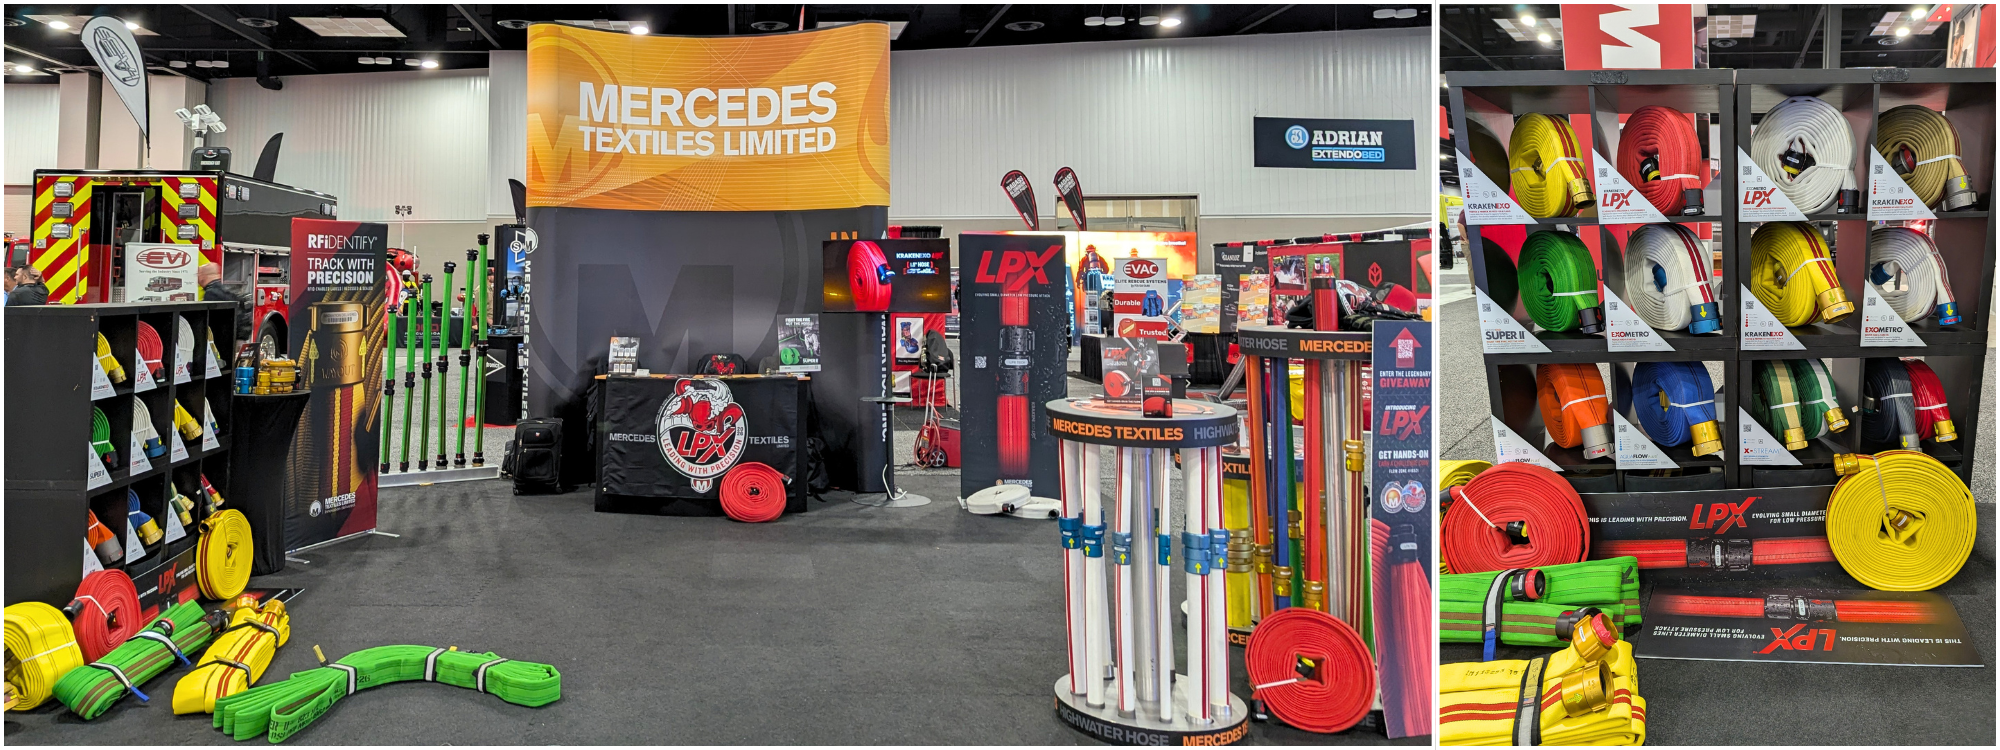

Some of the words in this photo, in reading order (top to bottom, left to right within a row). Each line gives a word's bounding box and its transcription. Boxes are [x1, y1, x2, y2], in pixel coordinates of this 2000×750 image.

[578, 81, 837, 127] MERCEDES
[578, 125, 716, 156] TEXTILES
[722, 126, 837, 156] LIMITED
[1312, 130, 1382, 146] ADRIAN
[1312, 150, 1382, 158] EXTENDOBED
[1602, 190, 1634, 209] LPX
[1743, 188, 1776, 207] LPX
[141, 251, 188, 265] EVI
[307, 258, 344, 270] TRACK
[347, 258, 374, 270] WITH
[975, 245, 1062, 291] LPX
[1124, 264, 1157, 274] EVAC
[308, 271, 373, 284] PRECISION
[1486, 331, 1517, 340] SUPER
[1256, 338, 1288, 350] HOSE
[1300, 340, 1372, 353] MERCEDE
[1104, 347, 1130, 361] LPX
[1380, 378, 1430, 388] GIVEAWAY
[1053, 418, 1112, 437] MERCEDES
[1114, 426, 1183, 441] TEXTILES
[1379, 406, 1430, 440] LPX
[610, 433, 656, 443] MERCEDES
[1193, 424, 1238, 440] HIGHWAT
[677, 427, 736, 463] LPX
[749, 436, 789, 445] TEXTILES
[662, 438, 685, 468] LEADING
[688, 465, 708, 474] WITH
[711, 439, 742, 472] PRECISION
[1378, 450, 1392, 459] GET
[1393, 450, 1429, 459] HANDS-ON
[1223, 463, 1250, 474] XTIL
[325, 492, 355, 505] MERCEDES
[1689, 497, 1758, 534] LPX
[158, 562, 178, 594] LPX
[1759, 624, 1836, 654] LPX
[1059, 706, 1123, 742] HIGHWATER
[1125, 730, 1170, 746] HOSE
[1183, 728, 1242, 746] MERCEDES
